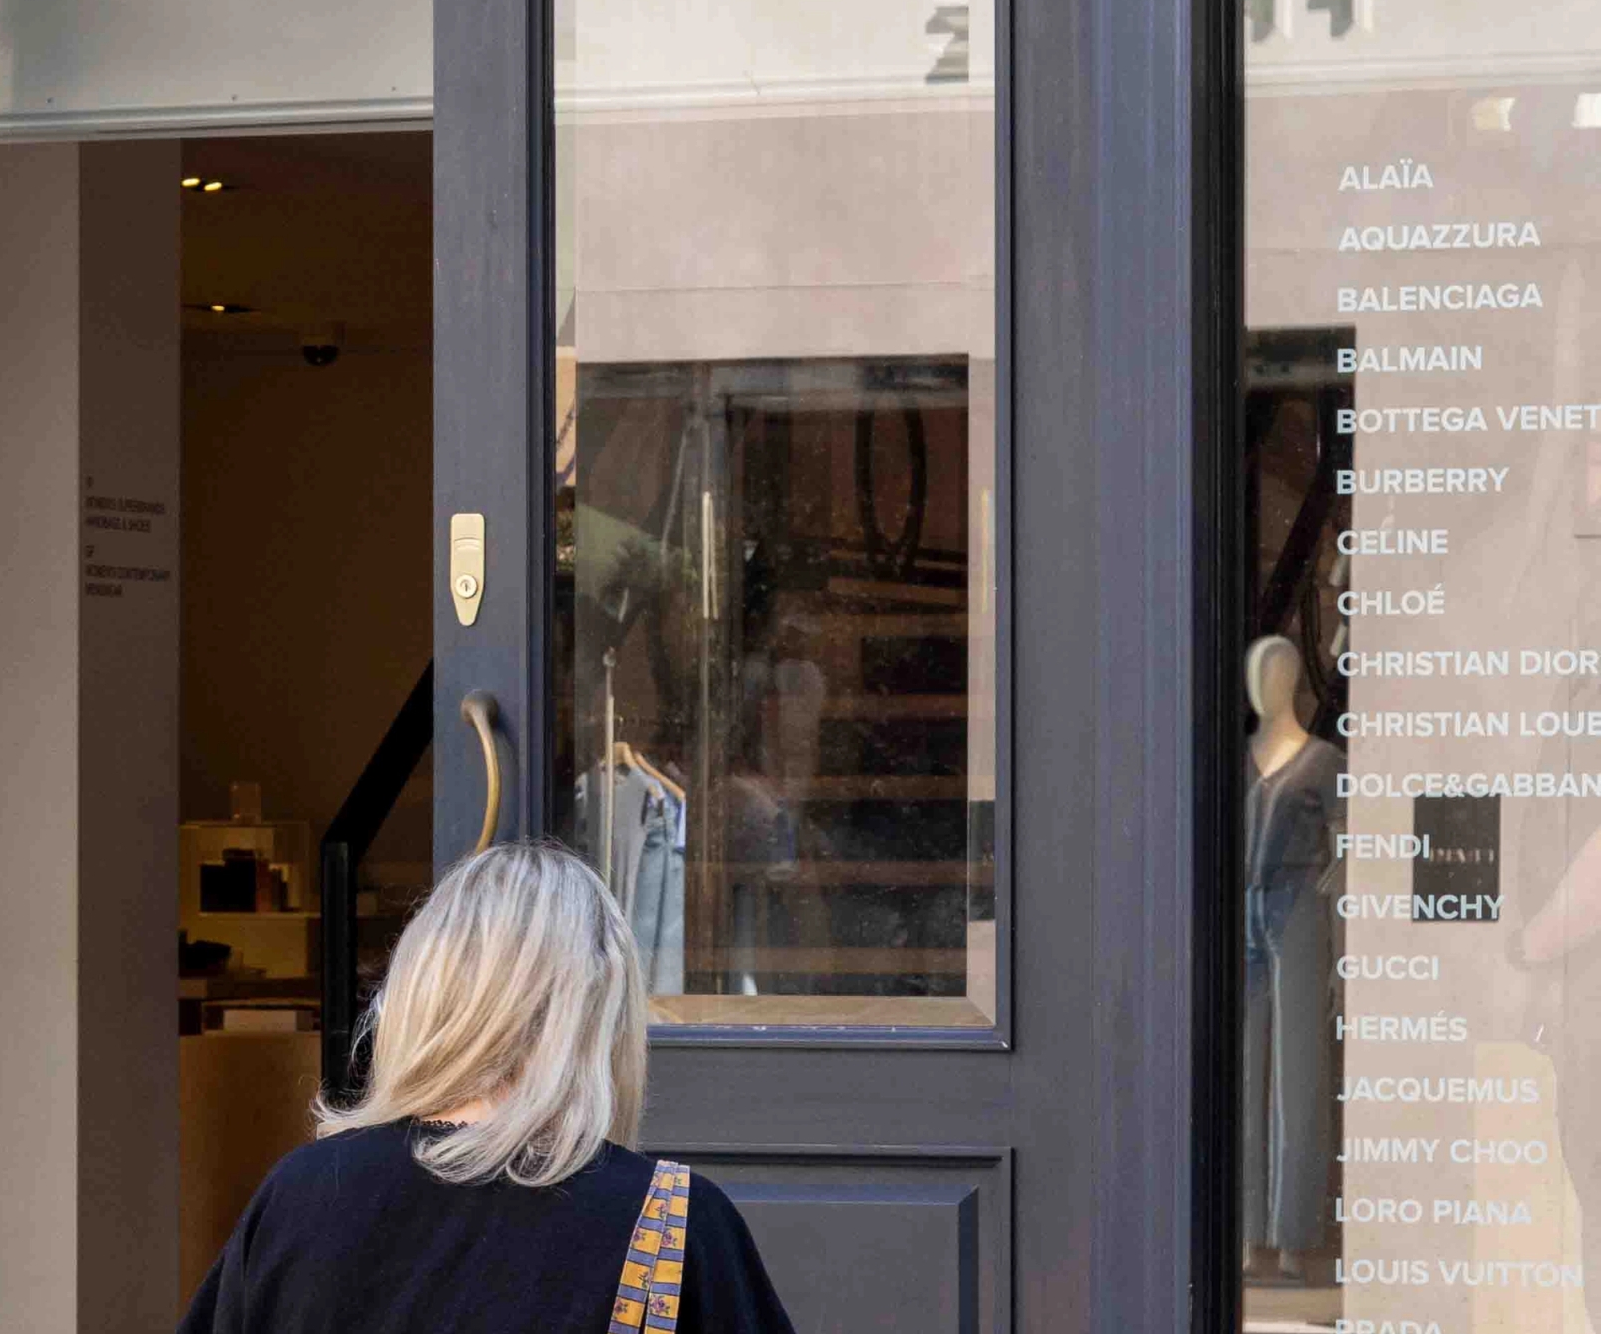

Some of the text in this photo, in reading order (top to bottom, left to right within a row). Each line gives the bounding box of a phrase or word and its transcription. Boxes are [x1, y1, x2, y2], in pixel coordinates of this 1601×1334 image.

[1337, 158, 1434, 191] ALAÏA
[1337, 220, 1541, 252] AQUAZZURA
[1336, 283, 1543, 313] BALENCIAGA
[1336, 345, 1482, 373] BALMAIN
[1336, 404, 1601, 434] BOTTEGA VENET
[1336, 467, 1510, 495] BURBERRY
[1336, 529, 1448, 555] CELINE
[1336, 583, 1444, 616] CHLOÉ
[1336, 649, 1599, 677] CHRISTIAN DIOR
[1336, 711, 1509, 738] CHRISTIAN
[1336, 772, 1601, 798] DOLCE&GABBAN
[1336, 833, 1430, 859] FENDI
[1336, 894, 1505, 920] GIVENCHY
[1336, 955, 1439, 980] GUCCI
[1336, 1077, 1540, 1104] JACQUEMUS
[1336, 1138, 1548, 1164] JIMMY CHOO
[1335, 1197, 1532, 1225] LORO PIANA
[1335, 1258, 1585, 1288] LOUIS VUITTON
